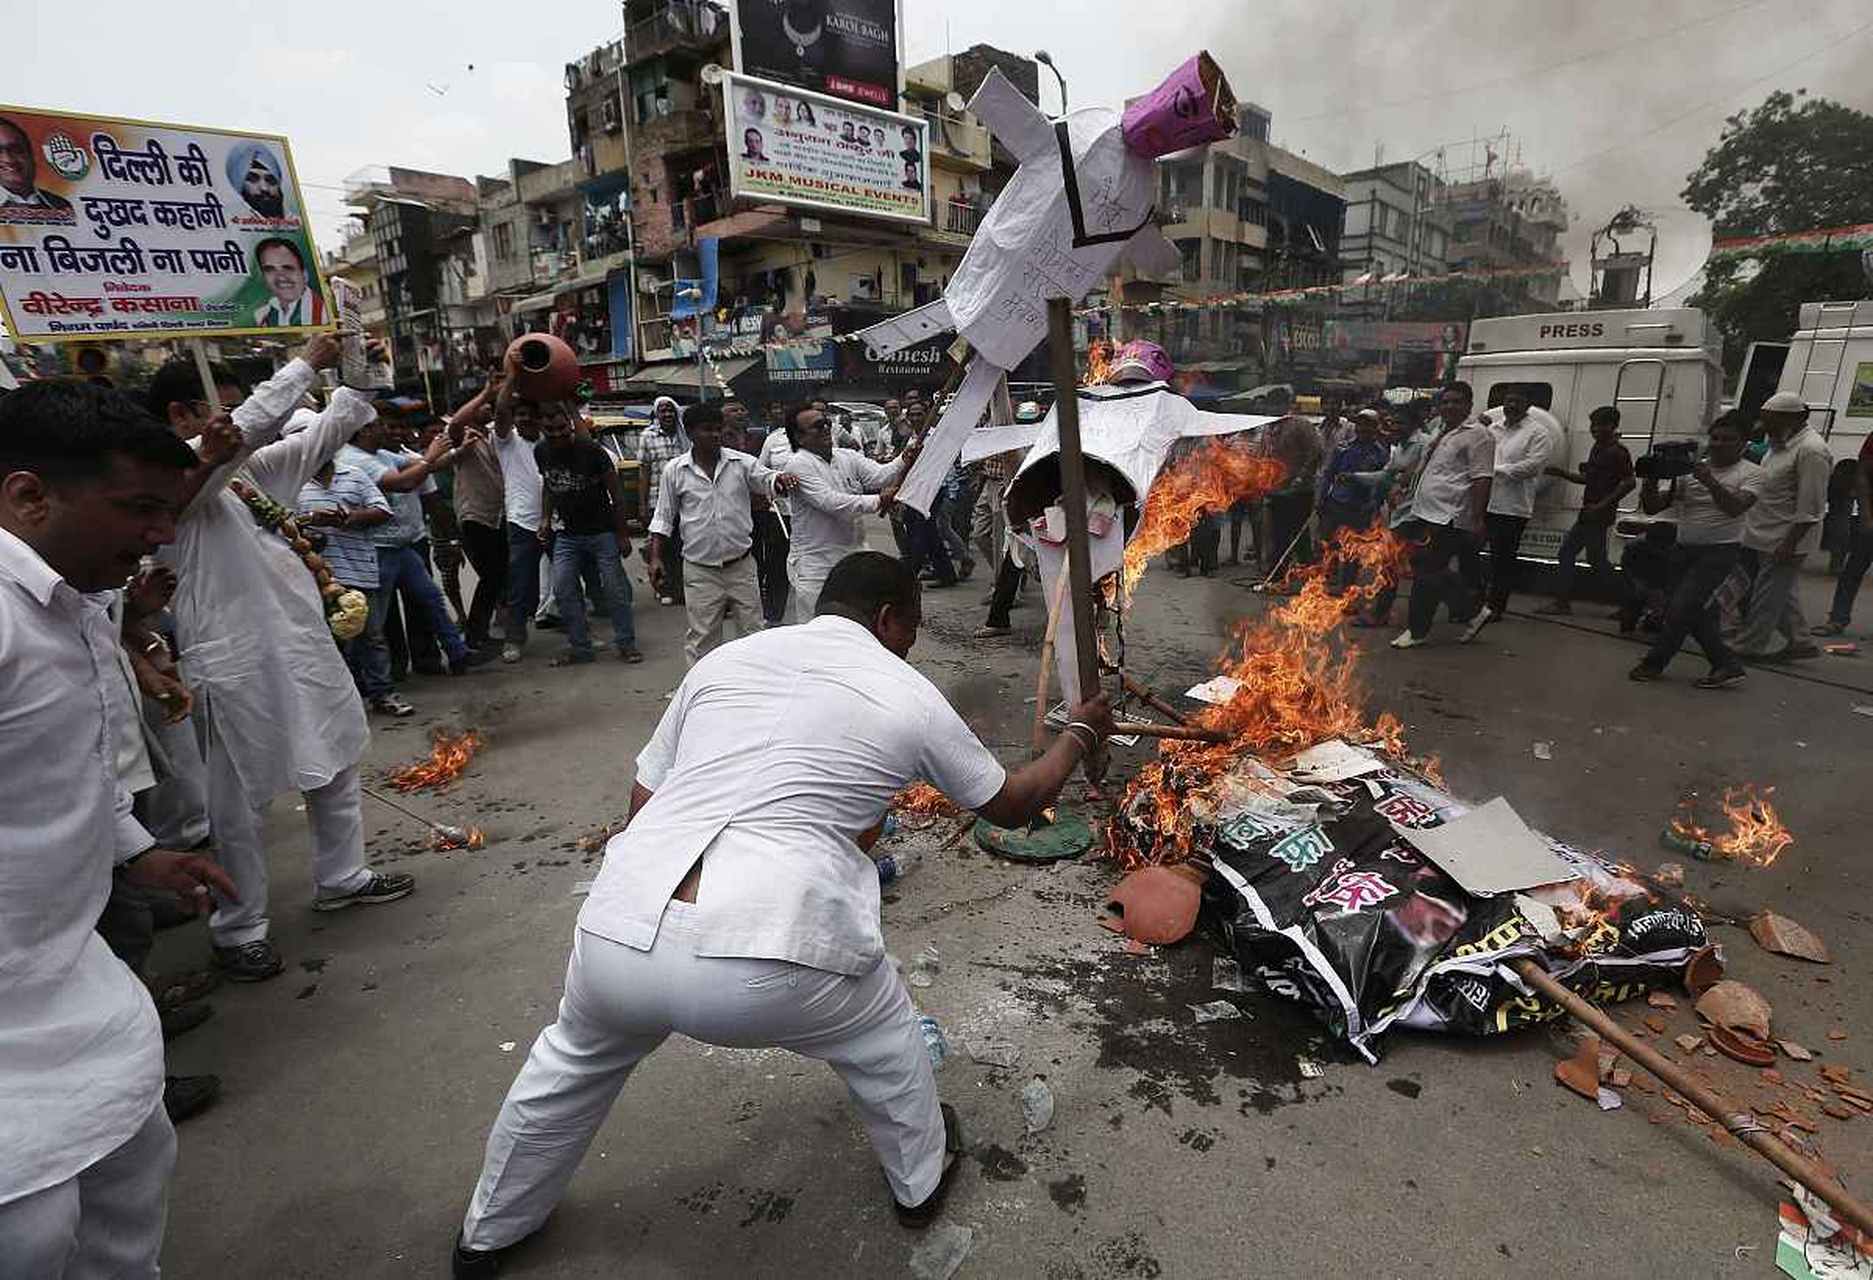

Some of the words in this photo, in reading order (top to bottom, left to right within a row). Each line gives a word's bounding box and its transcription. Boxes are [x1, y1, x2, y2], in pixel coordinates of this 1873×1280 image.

[92, 134, 174, 186] दिल्ली
[173, 142, 213, 187] की
[744, 169, 783, 183] JKM
[788, 174, 860, 197] MUSICAL
[79, 196, 149, 241] दुखद
[149, 191, 227, 231] कहानी
[0, 245, 41, 274] ना
[43, 234, 148, 275] बिजली
[149, 248, 186, 275] ना
[187, 239, 249, 275] पानी
[19, 290, 104, 319] वीरेन्द्र
[108, 296, 200, 314] कसाना
[1540, 323, 1604, 339] PRESS
[877, 365, 932, 375] Restaurant
